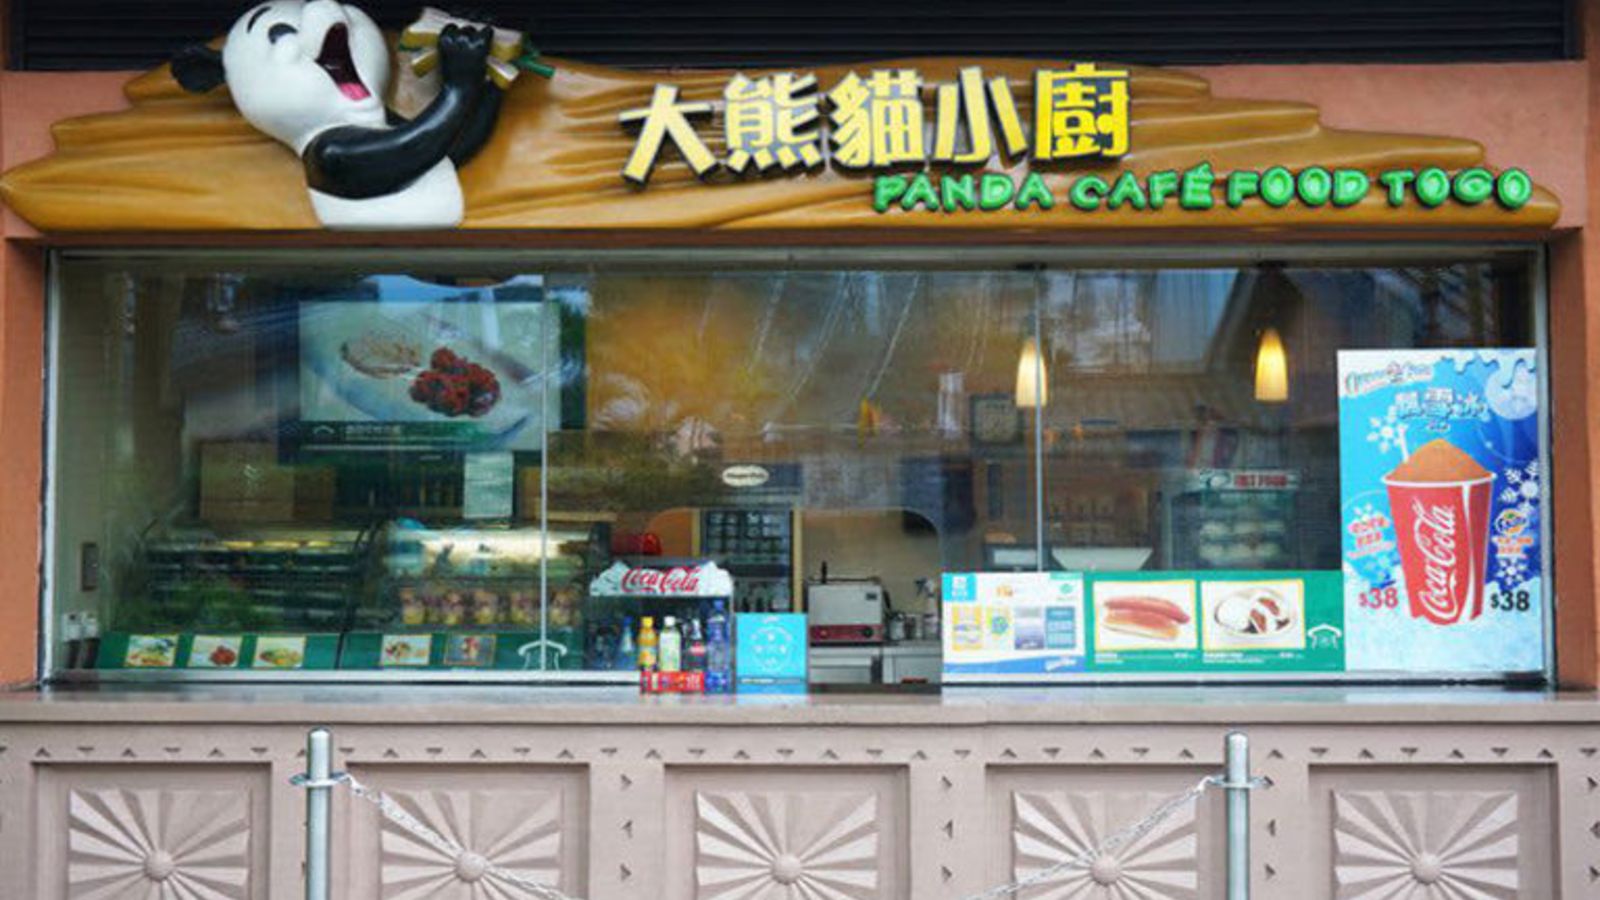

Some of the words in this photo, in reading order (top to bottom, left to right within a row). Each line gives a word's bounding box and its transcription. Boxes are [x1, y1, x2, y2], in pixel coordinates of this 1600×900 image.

[618, 63, 1130, 183] 大熊貓小廚
[873, 171, 1054, 212] PANDA
[1069, 161, 1215, 211] CAFÉ
[1226, 165, 1370, 209] FOOD
[1359, 587, 1399, 609] $38
[1490, 589, 1530, 611] $38
